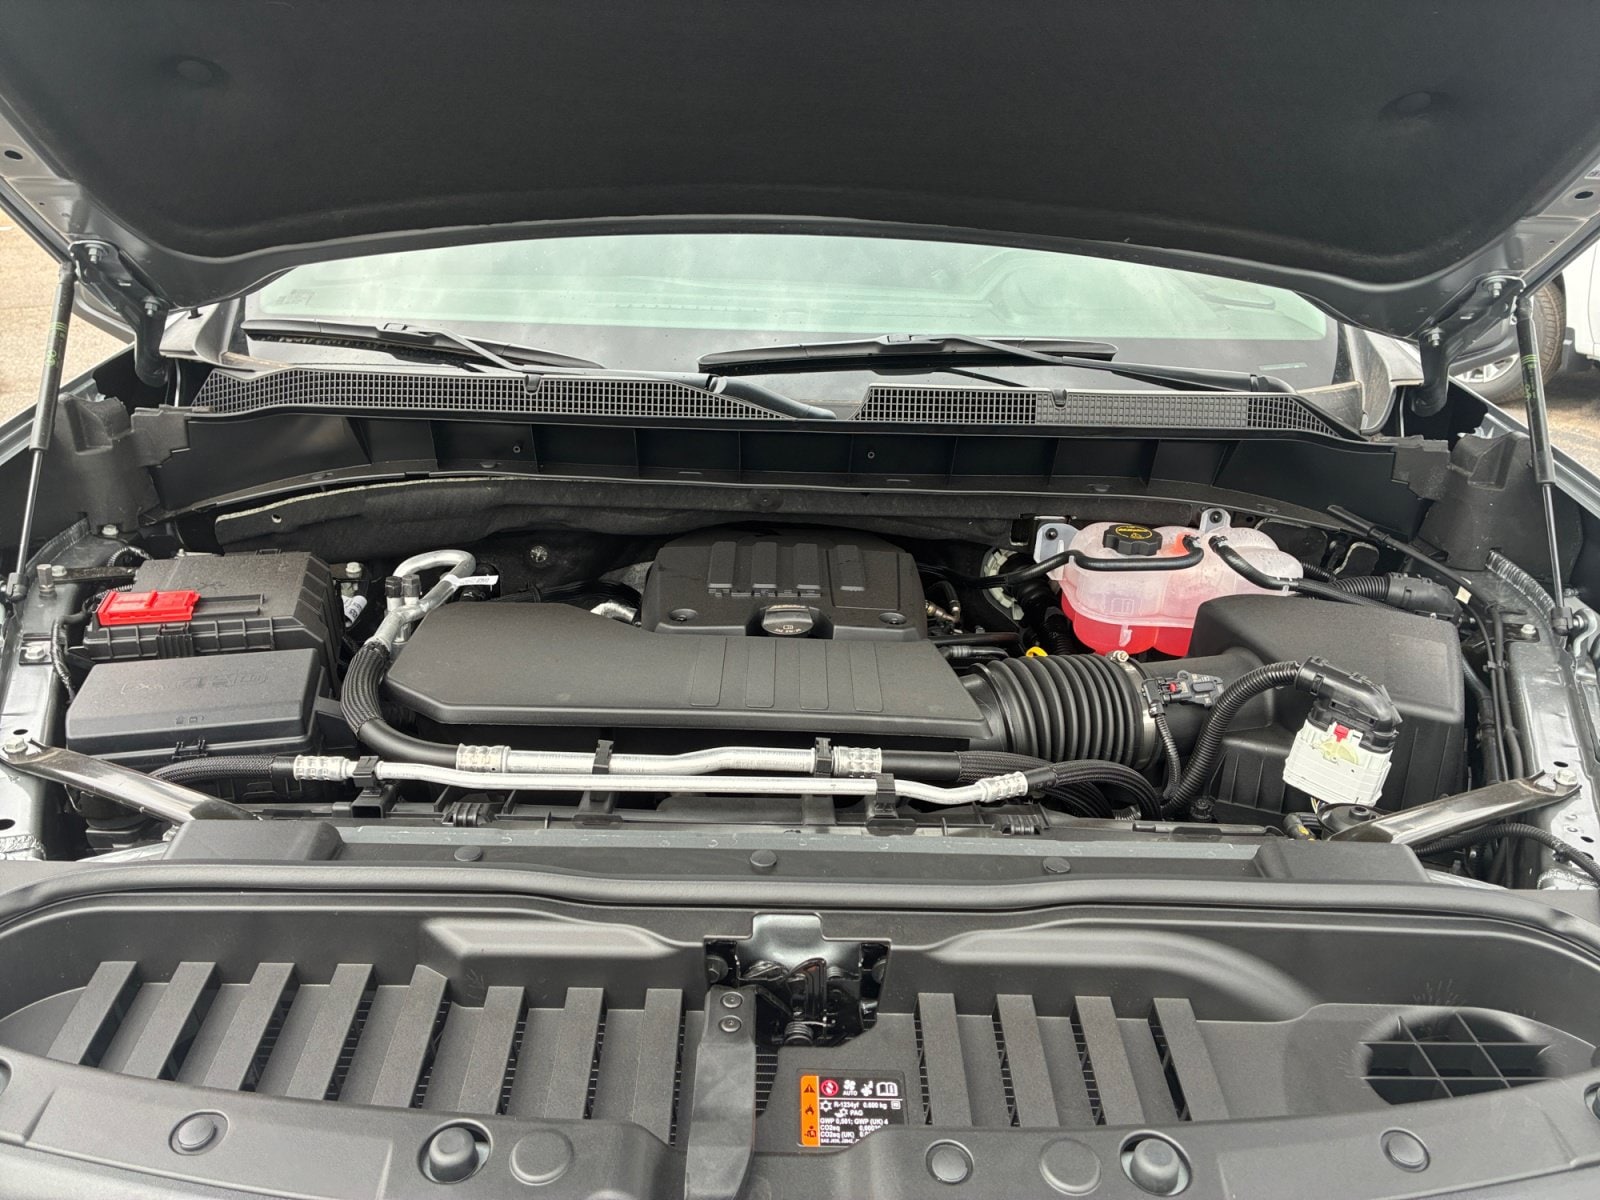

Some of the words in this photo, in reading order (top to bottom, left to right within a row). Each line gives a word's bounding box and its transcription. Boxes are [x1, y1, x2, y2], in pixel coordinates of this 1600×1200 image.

[879, 1101, 888, 1110] kg
[870, 1118, 883, 1126] (UK)
[841, 1131, 855, 1139] (UK)
